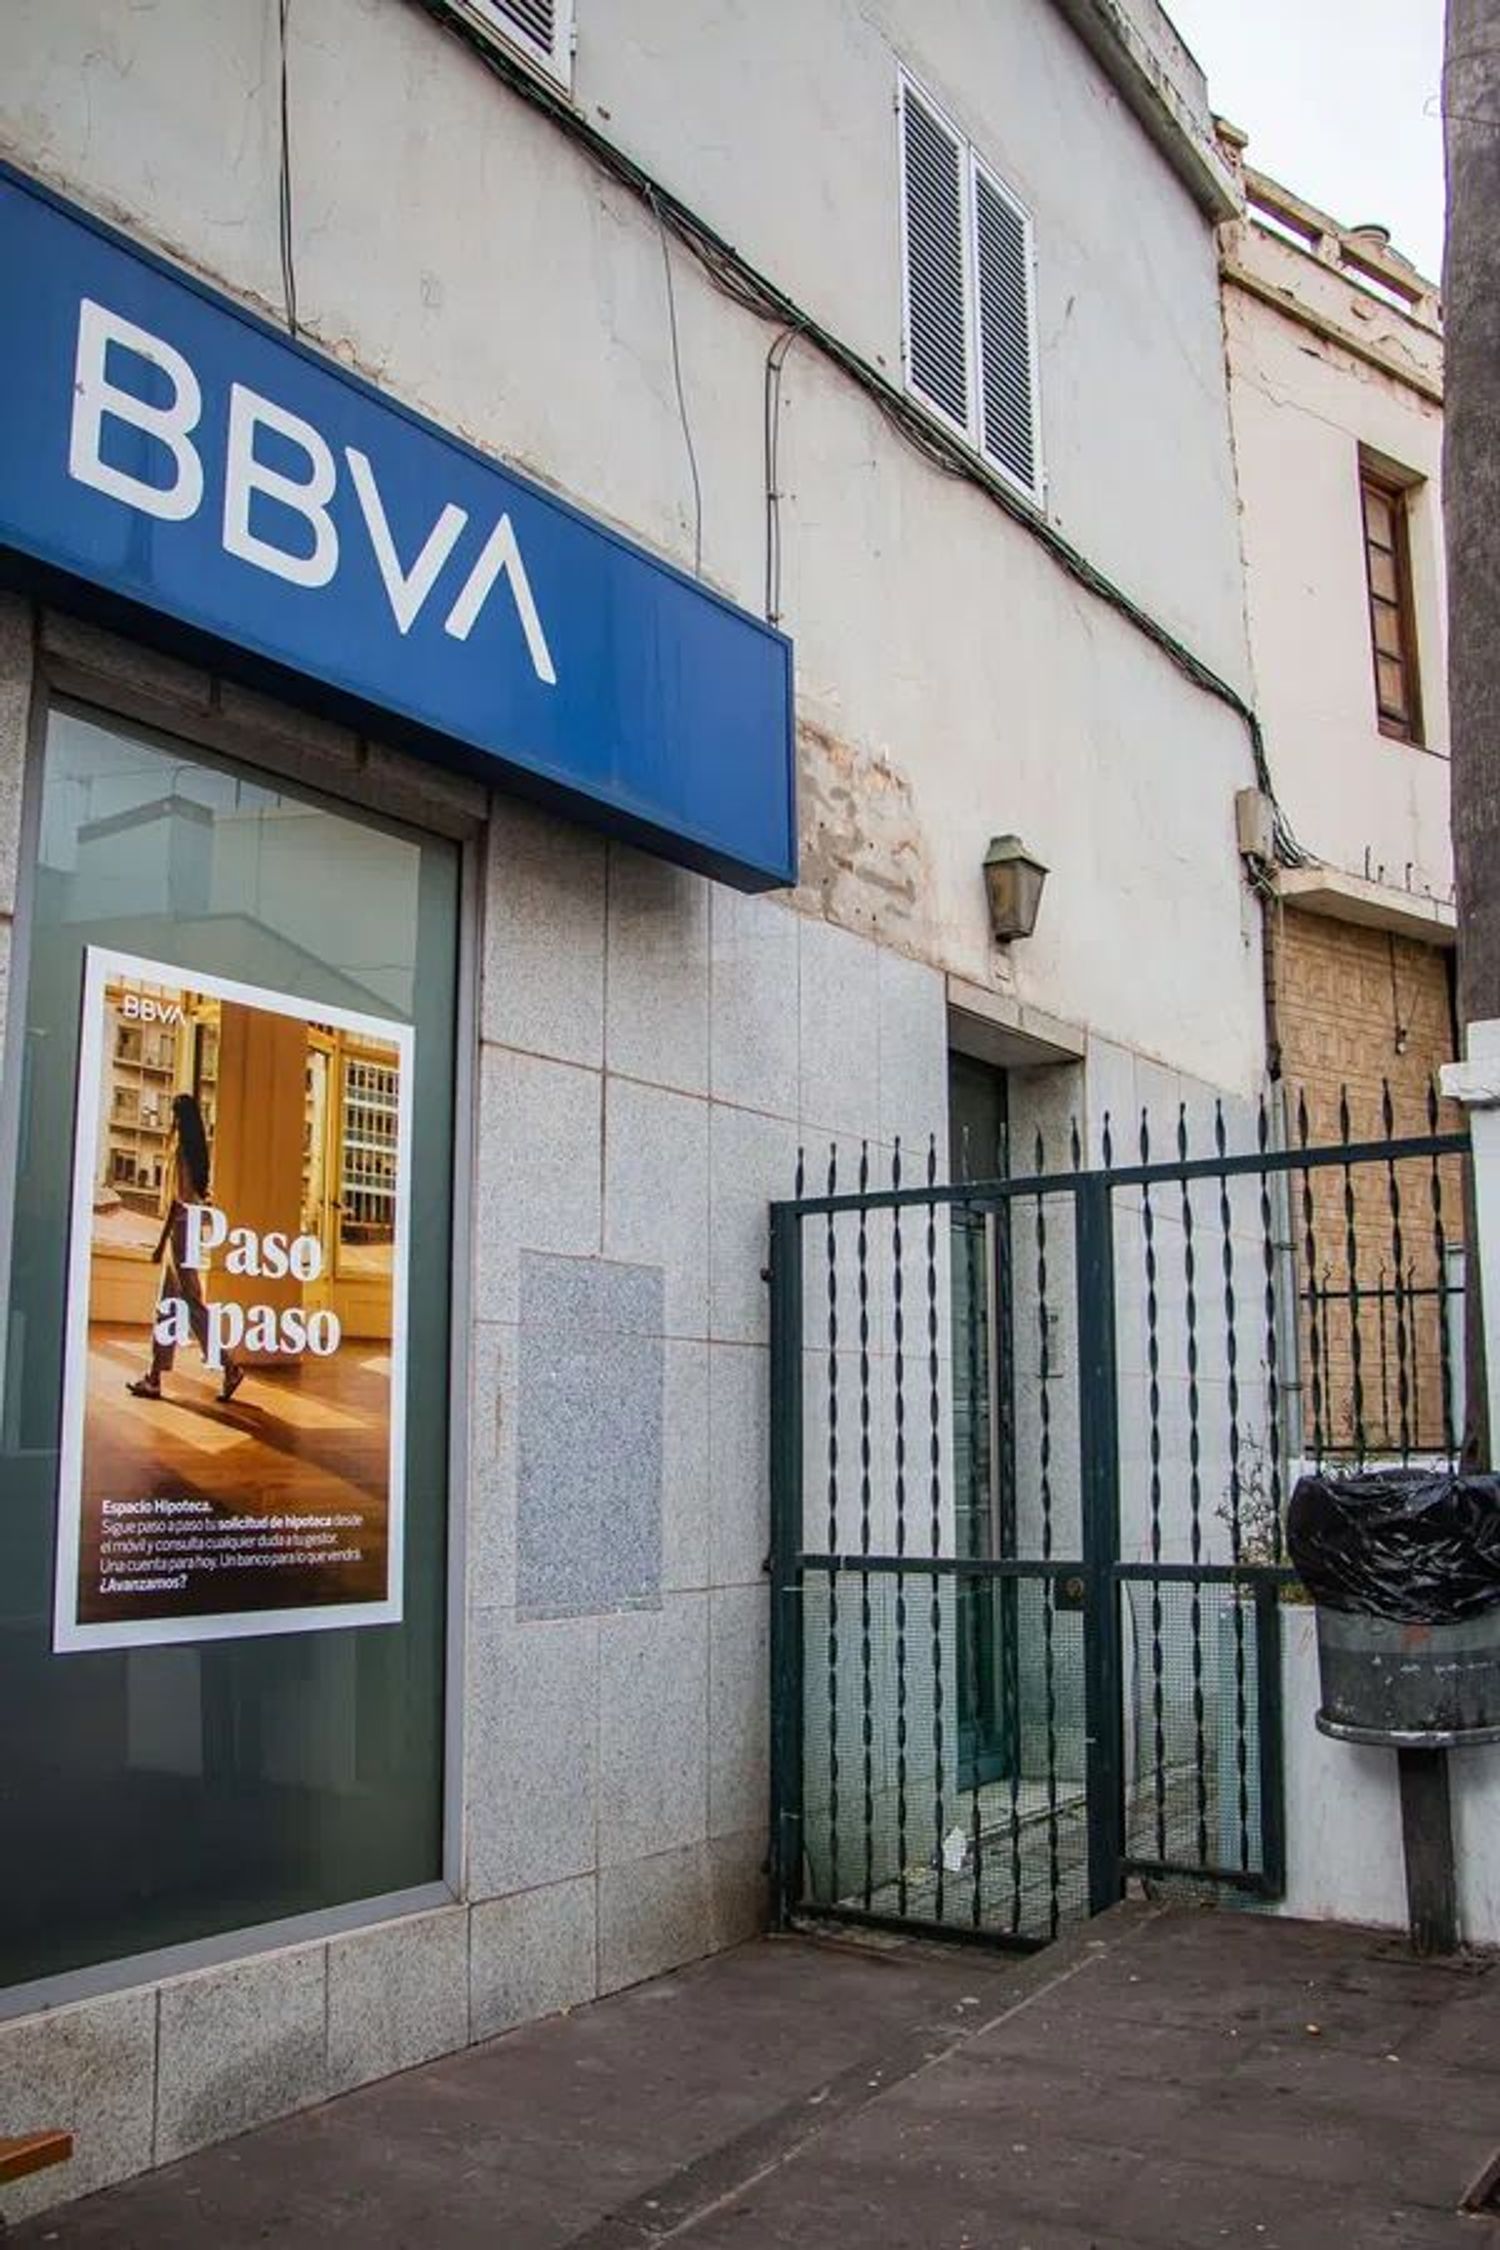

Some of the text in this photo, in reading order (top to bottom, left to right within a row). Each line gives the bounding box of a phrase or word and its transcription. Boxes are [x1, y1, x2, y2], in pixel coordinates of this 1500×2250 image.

[69, 298, 556, 685] BBVA
[124, 994, 186, 1025] BBVA
[178, 1202, 321, 1281] Paso
[154, 1297, 341, 1371] a paso
[102, 1500, 153, 1516] Espacio
[102, 1520, 136, 1537] Sigue
[138, 1521, 166, 1535] paso
[175, 1520, 202, 1534] paso
[218, 1515, 268, 1531] solicitud
[270, 1515, 283, 1528] de
[285, 1514, 331, 1530] hipoteca
[332, 1514, 363, 1527] desde
[100, 1540, 111, 1554] el
[155, 1537, 203, 1552] consulta
[204, 1536, 256, 1551] cualquier
[258, 1534, 282, 1546] duda
[100, 1559, 126, 1574] Una
[127, 1557, 168, 1572] cuenta
[168, 1558, 195, 1573] para
[219, 1552, 237, 1567] Un
[237, 1551, 271, 1567] banco
[100, 1573, 188, 1594] ¿Avanzamos?
